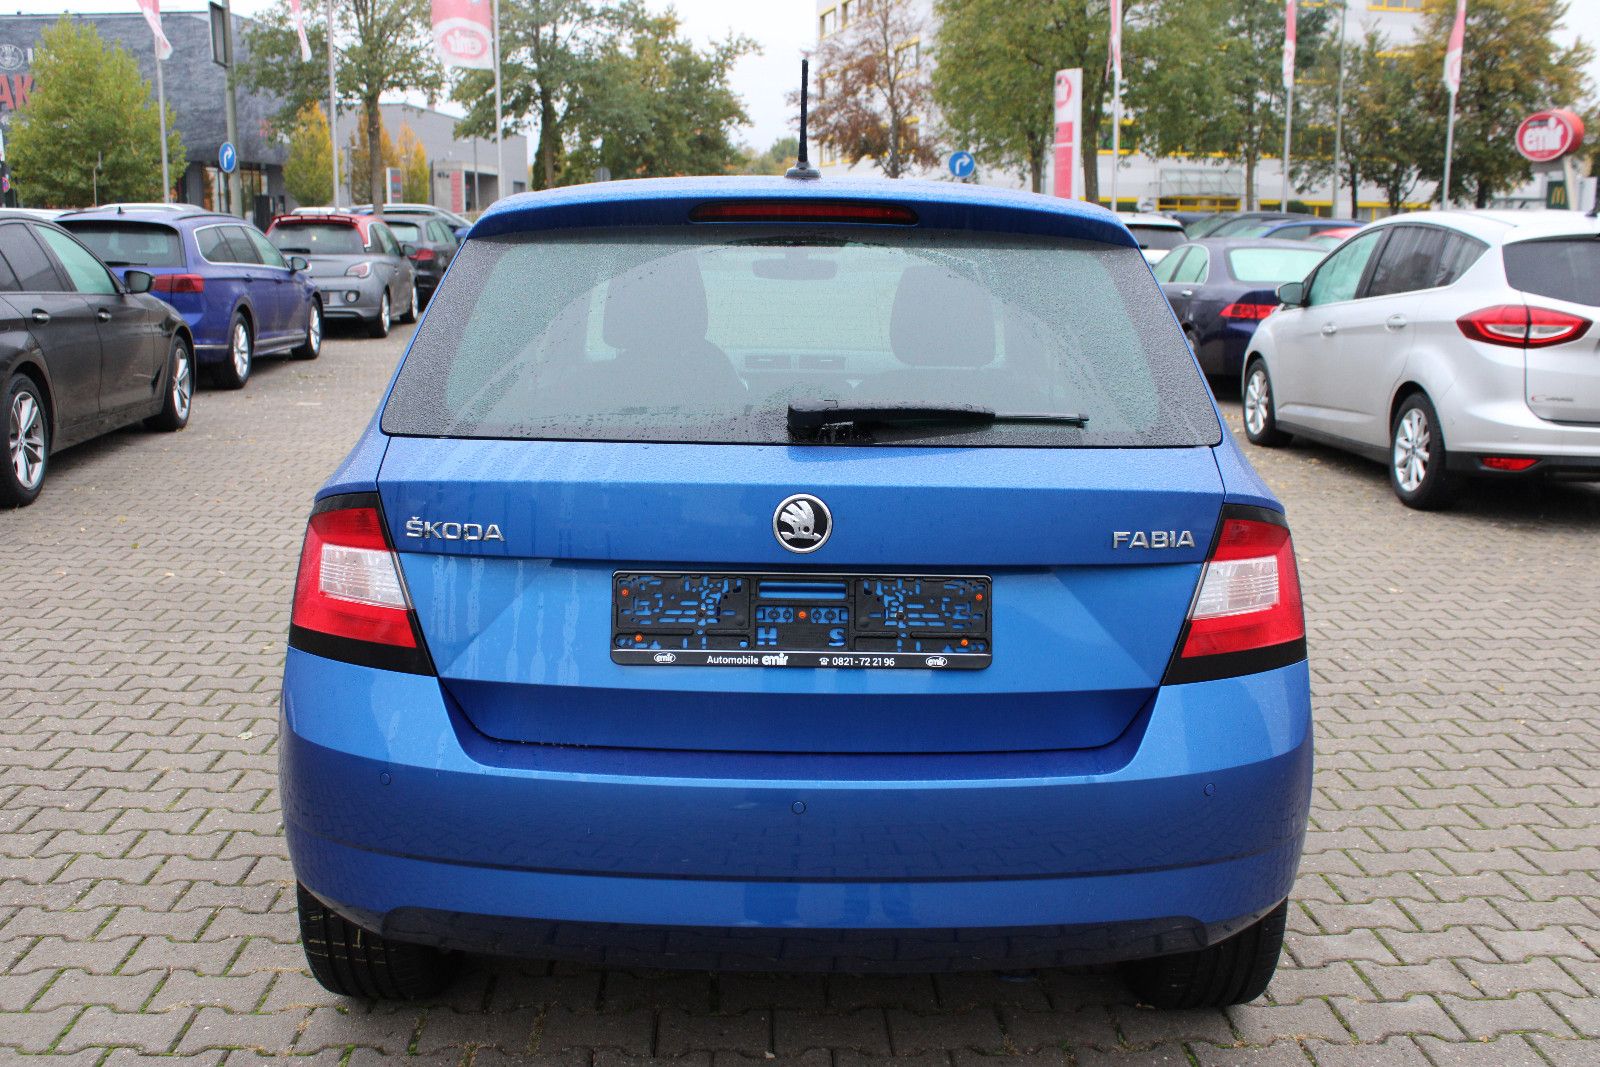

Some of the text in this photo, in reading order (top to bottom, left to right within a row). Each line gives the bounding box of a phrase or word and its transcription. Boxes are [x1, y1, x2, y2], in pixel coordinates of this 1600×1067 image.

[1523, 116, 1563, 151] emir
[405, 516, 505, 542] ŠKODA
[1113, 530, 1196, 549] FABIA
[655, 653, 673, 662] emir
[706, 652, 789, 666] Automobile emir
